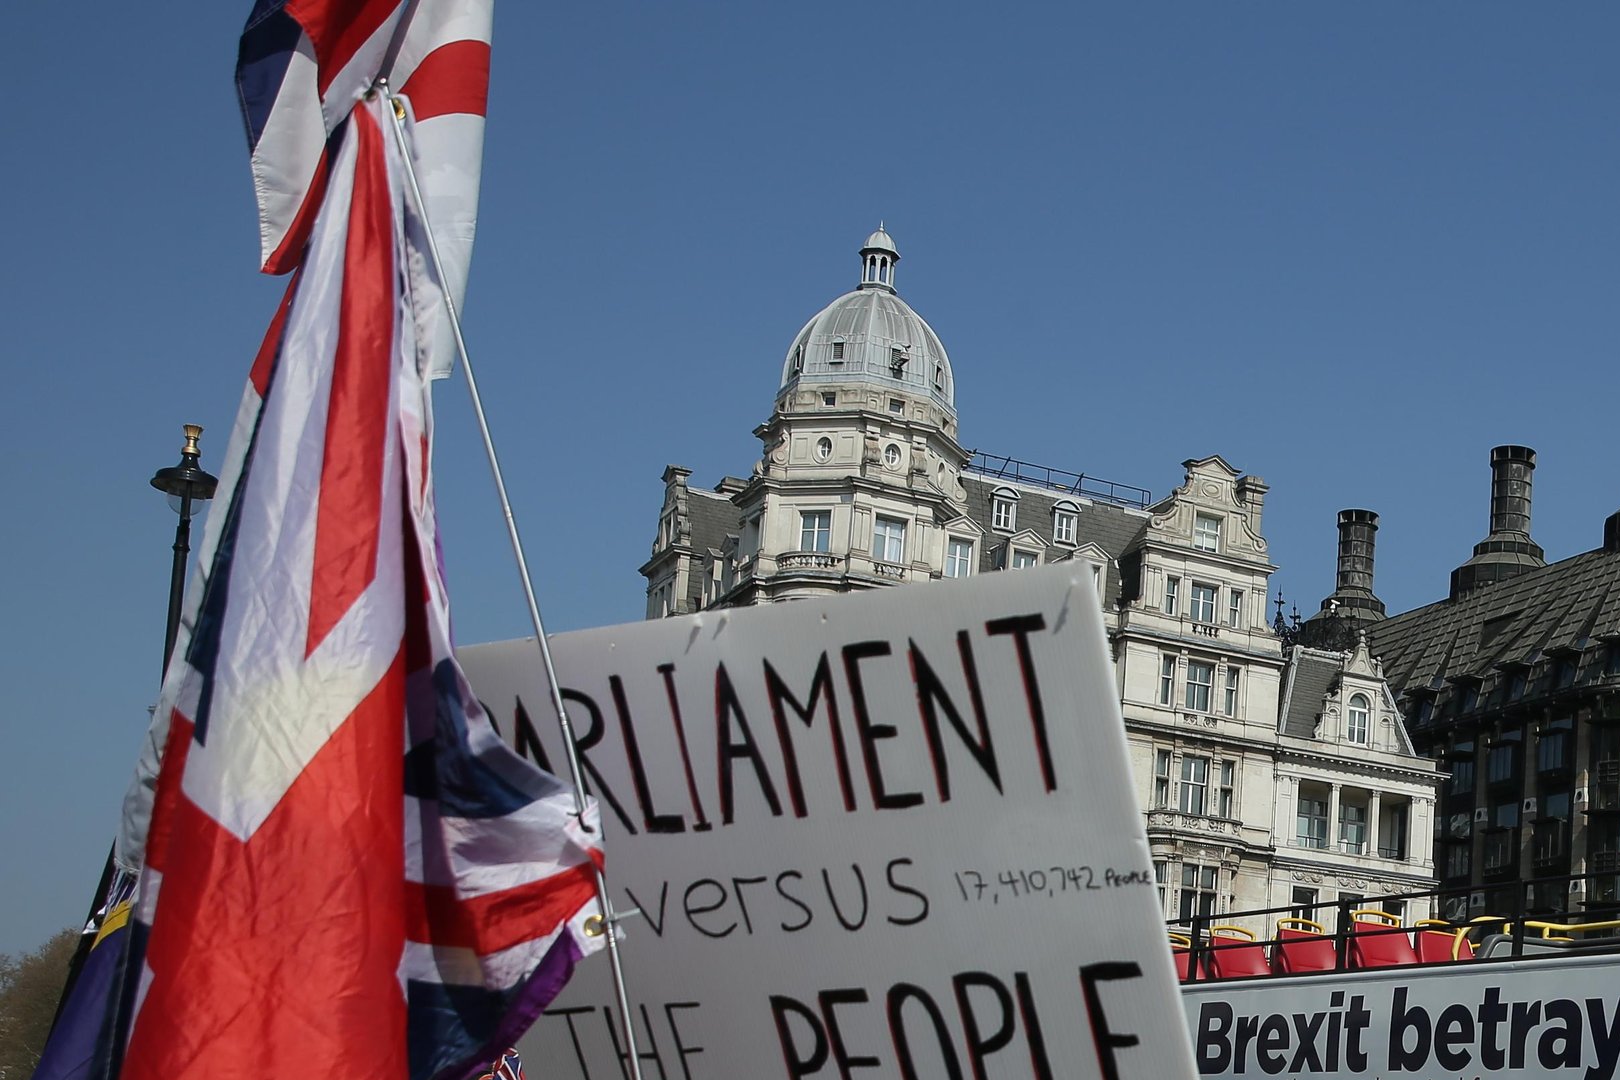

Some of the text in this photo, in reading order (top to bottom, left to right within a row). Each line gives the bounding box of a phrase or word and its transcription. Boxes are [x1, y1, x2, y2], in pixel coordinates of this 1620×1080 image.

[478, 613, 1057, 841] ARLIAMENT
[955, 867, 1101, 904] 17,410,742
[1196, 990, 1371, 1075] Brexit
